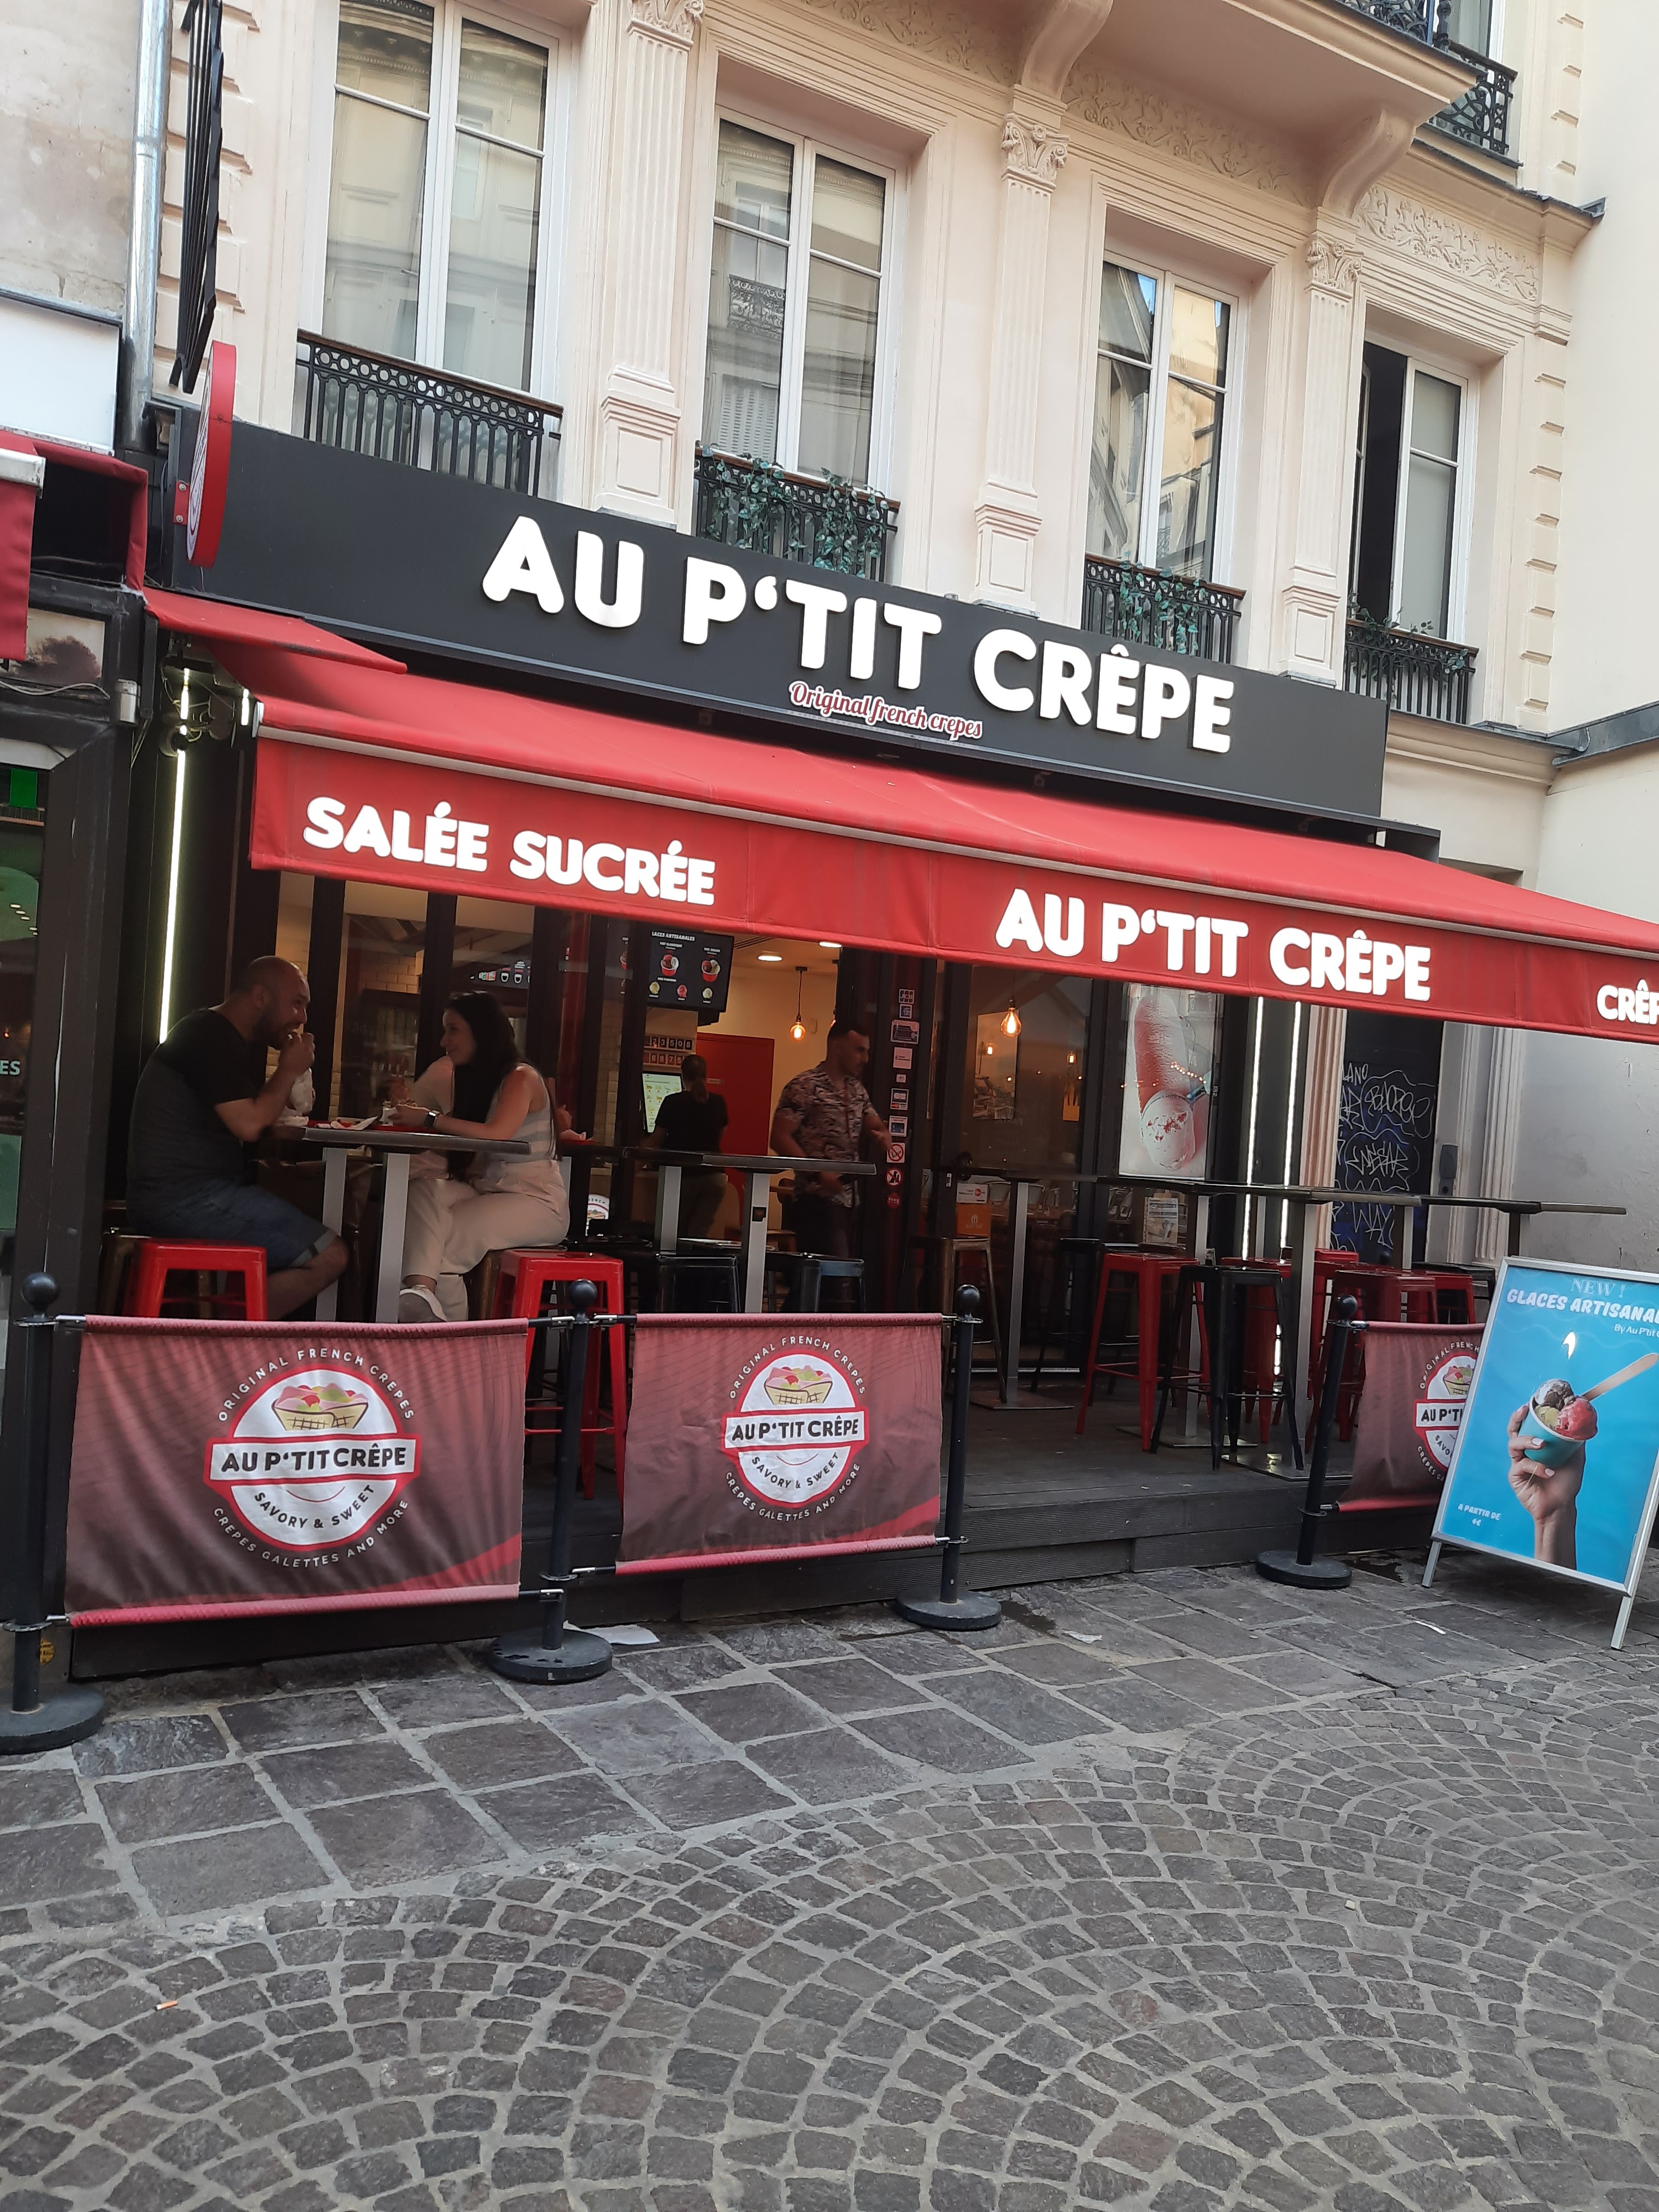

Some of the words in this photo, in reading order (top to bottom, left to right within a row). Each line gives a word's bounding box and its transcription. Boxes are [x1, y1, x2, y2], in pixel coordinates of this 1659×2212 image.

[482, 516, 644, 628] AU
[683, 557, 942, 690] P'TIT
[974, 629, 1234, 753] CRÊPE
[791, 682, 870, 716] Original
[869, 698, 926, 728] french
[930, 715, 982, 739] crepes
[304, 797, 489, 872] SALÉE
[510, 831, 715, 906] SUCRÉE
[995, 888, 1085, 957] AU
[1102, 902, 1249, 977] P'TIT
[1270, 928, 1431, 1001] CRÊPE
[1506, 1288, 1568, 1311] GLACES
[1571, 1278, 1615, 1297] NEW
[1614, 1323, 1626, 1334] By
[1626, 1326, 1638, 1334] Au
[218, 1357, 288, 1421] ORIGINAL
[297, 1348, 364, 1366] FRENCH
[369, 1365, 414, 1420] CREPES
[730, 1343, 775, 1399] ORIGINAL
[781, 1335, 830, 1350] FRENCH
[834, 1349, 865, 1394] CREPES
[1420, 1347, 1449, 1389] ORIGINAL
[1451, 1341, 1479, 1353] FRENCH
[732, 1423, 755, 1441] AU
[808, 1415, 859, 1437] CRÊPE
[1421, 1408, 1436, 1422] AU
[1439, 1408, 1463, 1422] P'TI
[221, 1452, 258, 1472] AU
[333, 1443, 406, 1468] CRÊPE
[1417, 1446, 1436, 1475] CREPES
[1434, 1434, 1453, 1458] SAVO
[752, 1457, 791, 1489] SAVORY
[795, 1480, 801, 1489] &
[806, 1452, 838, 1486] SWEET
[254, 1492, 308, 1528] SAVORY
[314, 1519, 324, 1528] &
[332, 1485, 374, 1526] SWEET
[726, 1472, 757, 1511] CREPES
[759, 1508, 810, 1521] GALETTES
[816, 1495, 836, 1514] AND
[838, 1463, 860, 1494] MORE
[1464, 1505, 1490, 1518] PARTIR
[1490, 1512, 1501, 1520] DE
[213, 1507, 257, 1552] CREPES
[262, 1551, 339, 1568] GALETTES
[347, 1536, 375, 1558] AND
[376, 1500, 409, 1535] MORE
